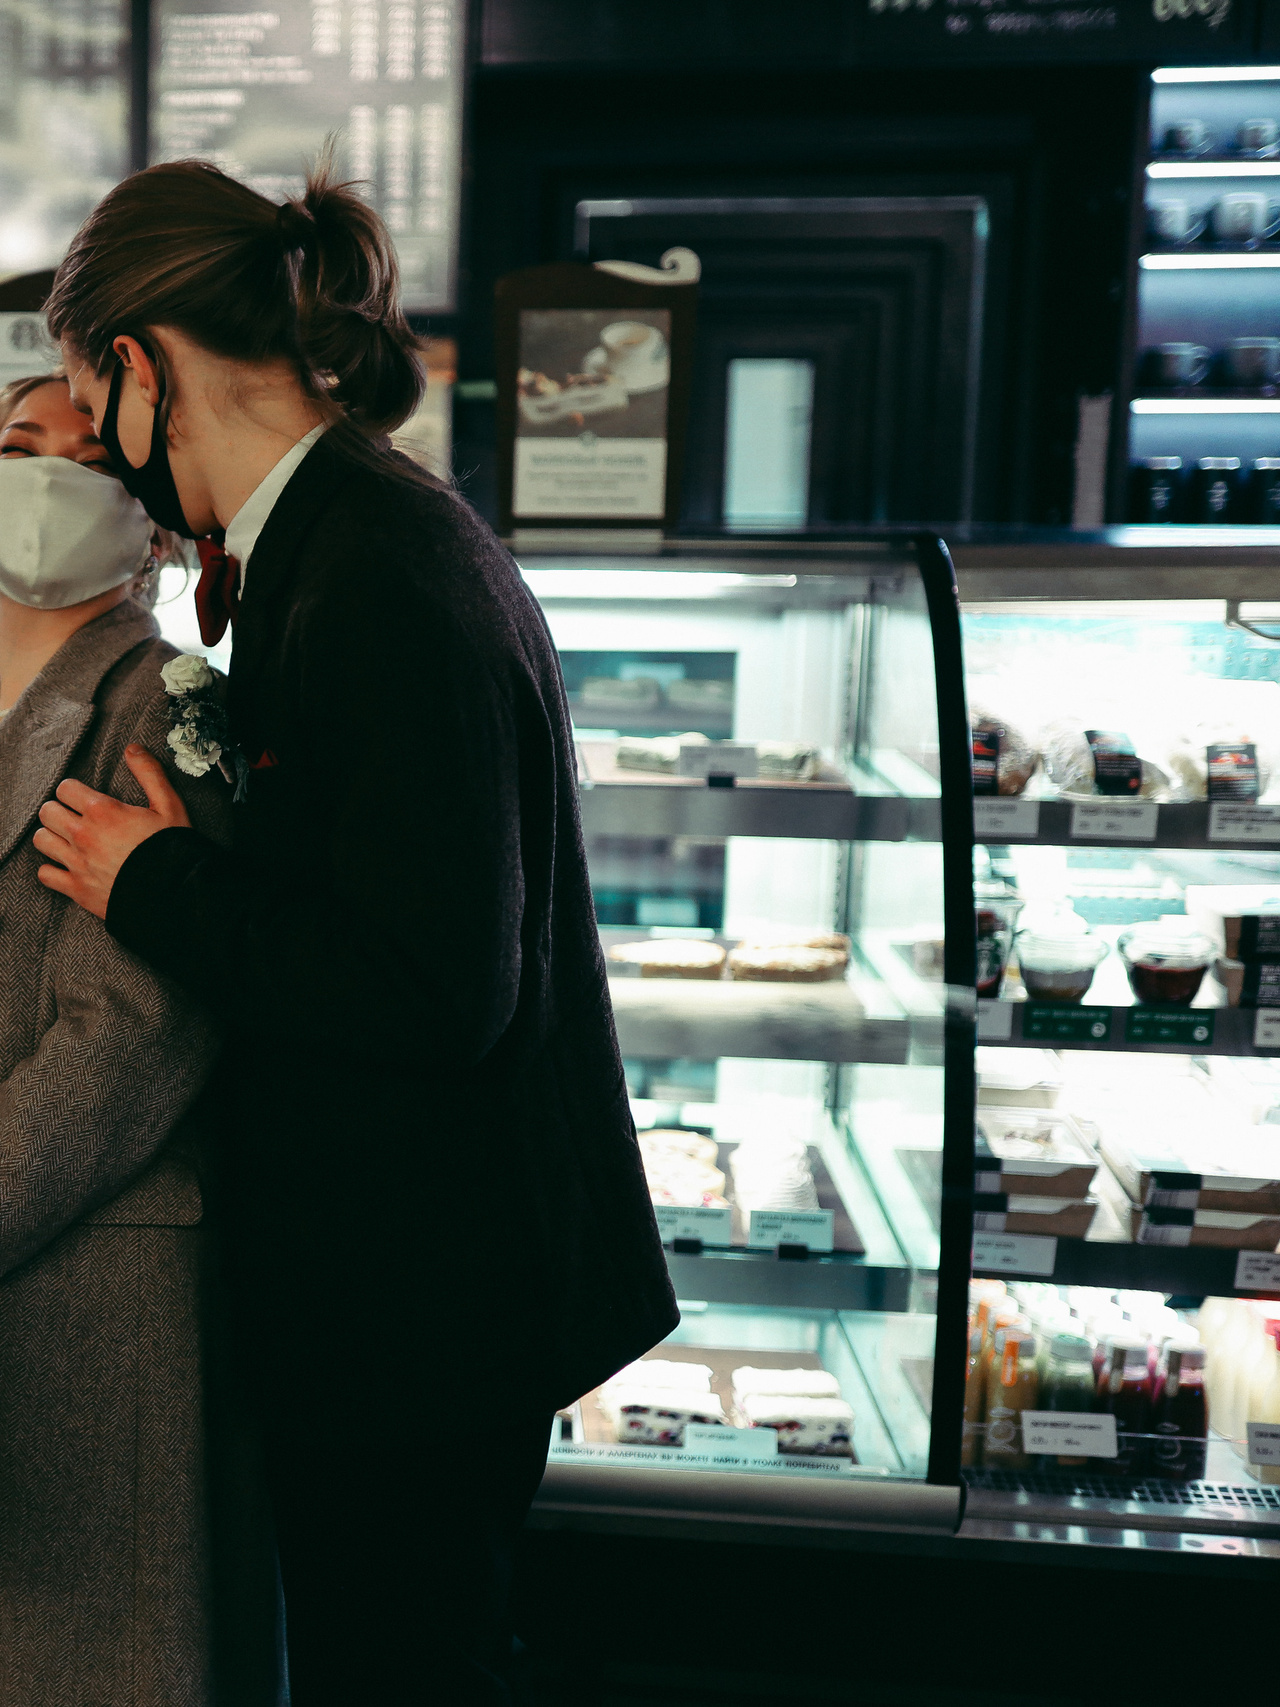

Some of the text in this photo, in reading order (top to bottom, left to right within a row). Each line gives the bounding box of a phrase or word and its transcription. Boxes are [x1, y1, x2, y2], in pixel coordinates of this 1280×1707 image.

[552, 1446, 595, 1456] ЦЕННОСТИ
[598, 1447, 605, 1457] И
[608, 1449, 658, 1460] АЛЛЕРГЕНАХ
[713, 1455, 741, 1465] НАЙТИ
[753, 1458, 783, 1468] УГОЛКЕ
[785, 1460, 841, 1471] ПОТРЕБИТЕЛЯ
